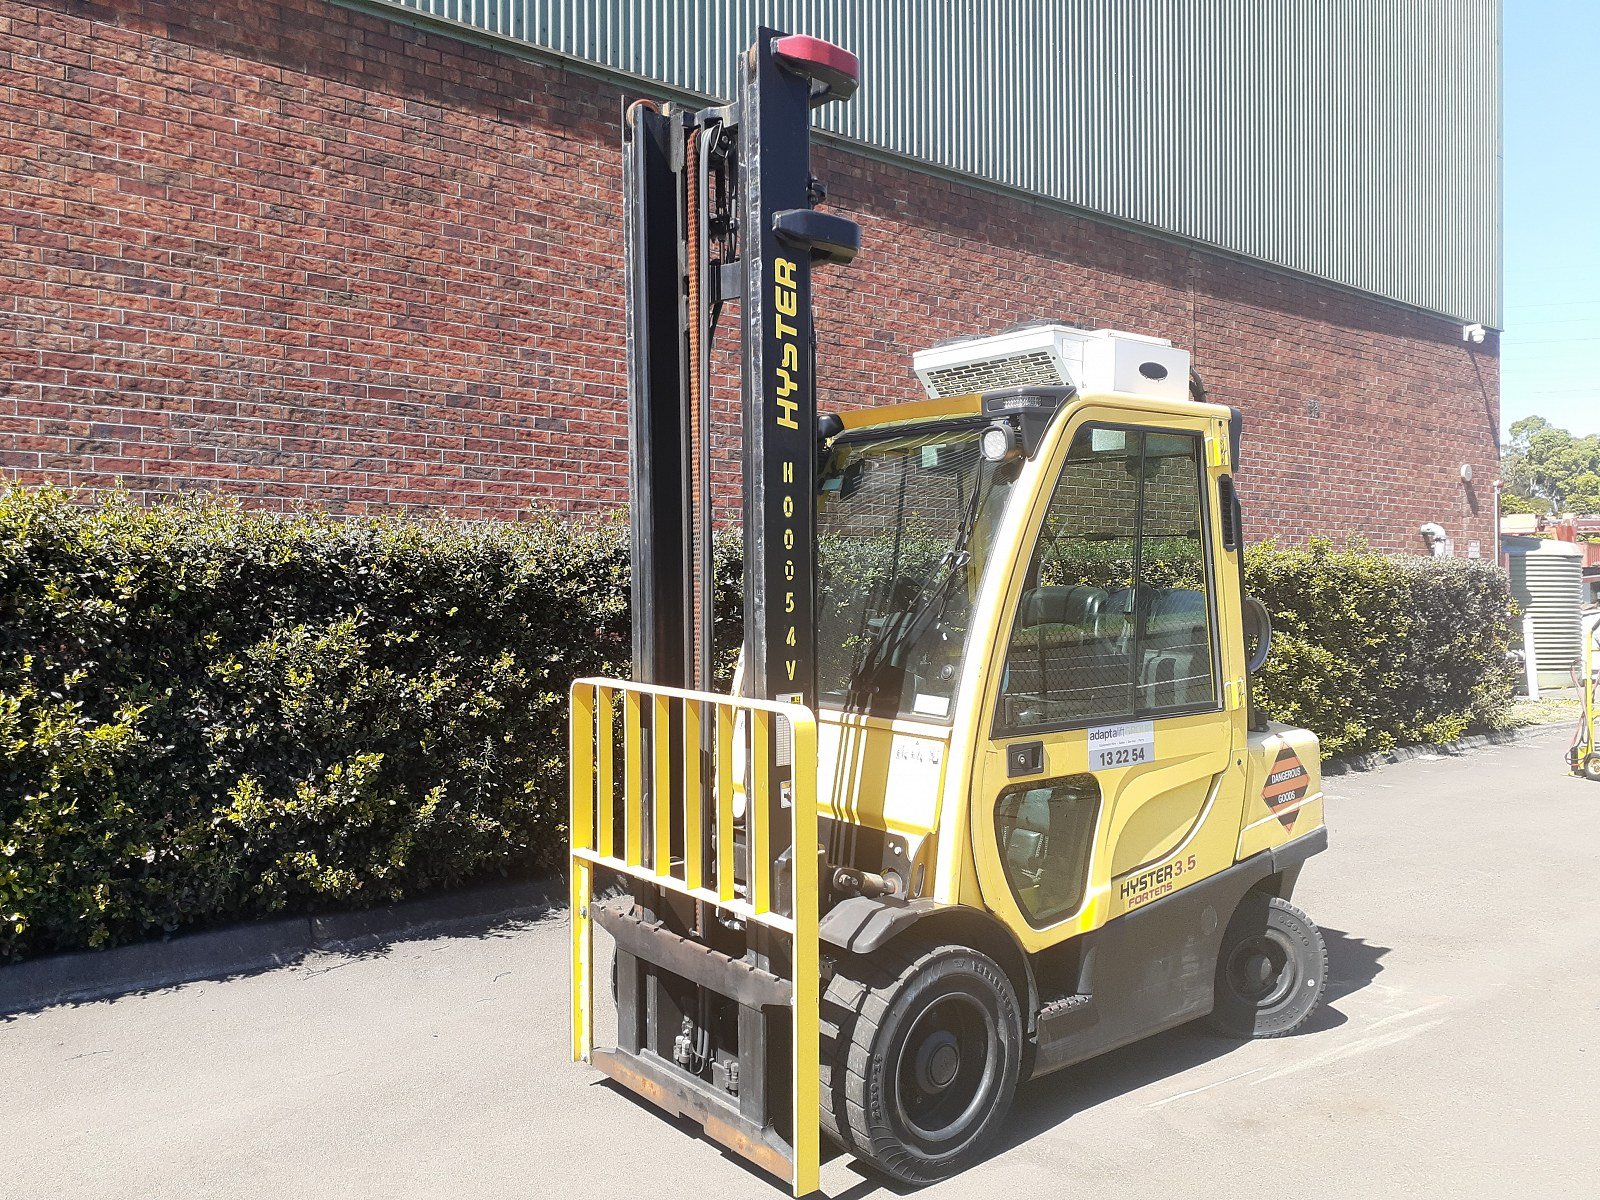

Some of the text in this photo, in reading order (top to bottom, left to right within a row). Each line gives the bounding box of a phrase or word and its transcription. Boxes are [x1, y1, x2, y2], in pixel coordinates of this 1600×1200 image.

[775, 257, 799, 430] HYSTER
[1100, 747, 1145, 766] 13 22 54
[1271, 767, 1301, 784] DANGEROUS
[1277, 790, 1296, 804] GOODS
[1120, 854, 1197, 899] HYSTER 3.5
[1128, 881, 1173, 908] FORTENS
